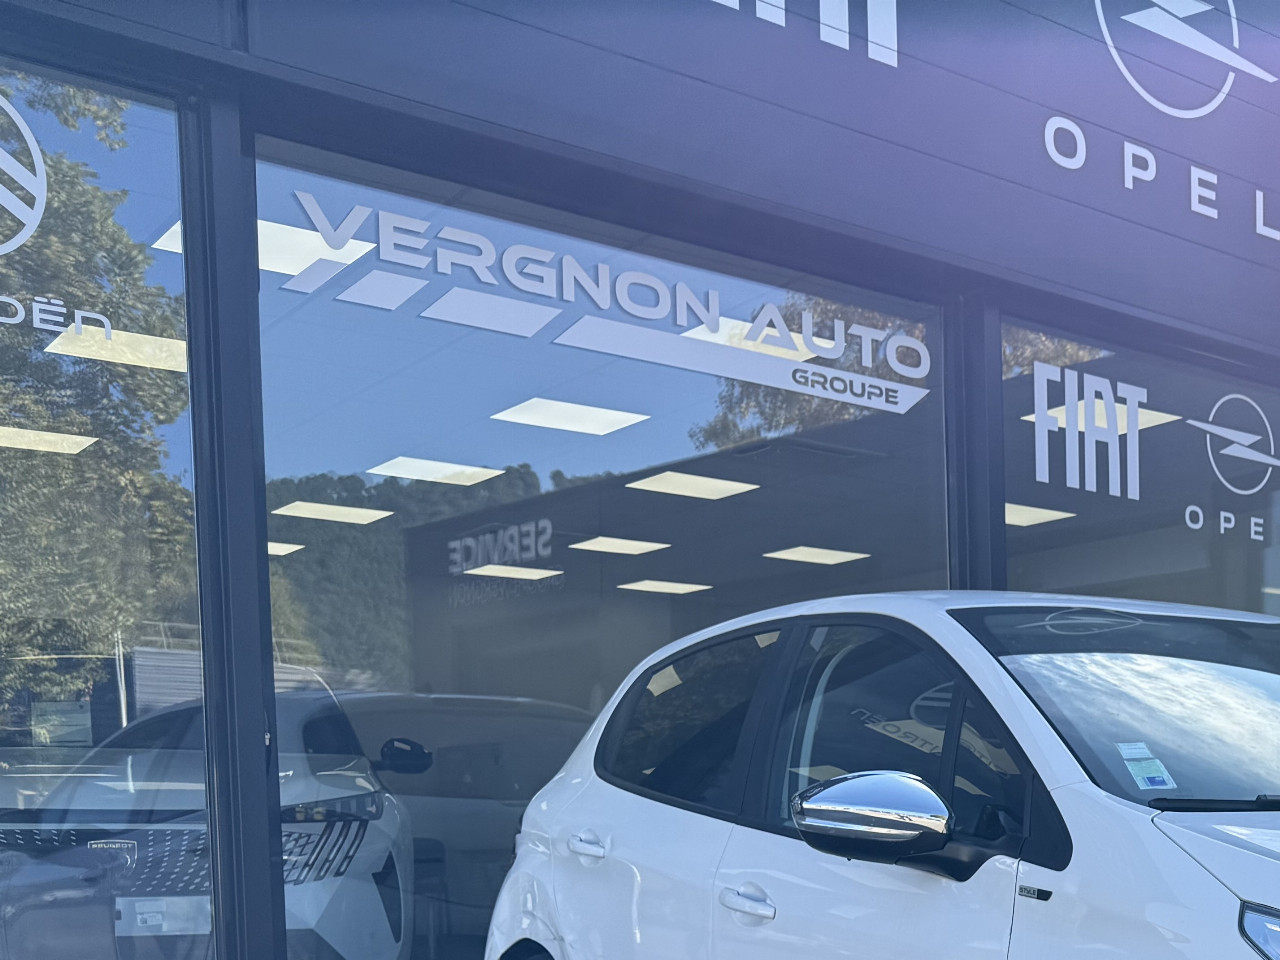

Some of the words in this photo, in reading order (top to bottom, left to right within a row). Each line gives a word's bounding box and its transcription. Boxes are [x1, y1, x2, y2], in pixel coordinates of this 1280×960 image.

[1044, 116, 1280, 241] OPEL
[293, 190, 721, 333] VERGNON
[740, 303, 931, 379] AUTO
[791, 367, 900, 405] GROUPE
[1034, 361, 1147, 501] FIAT
